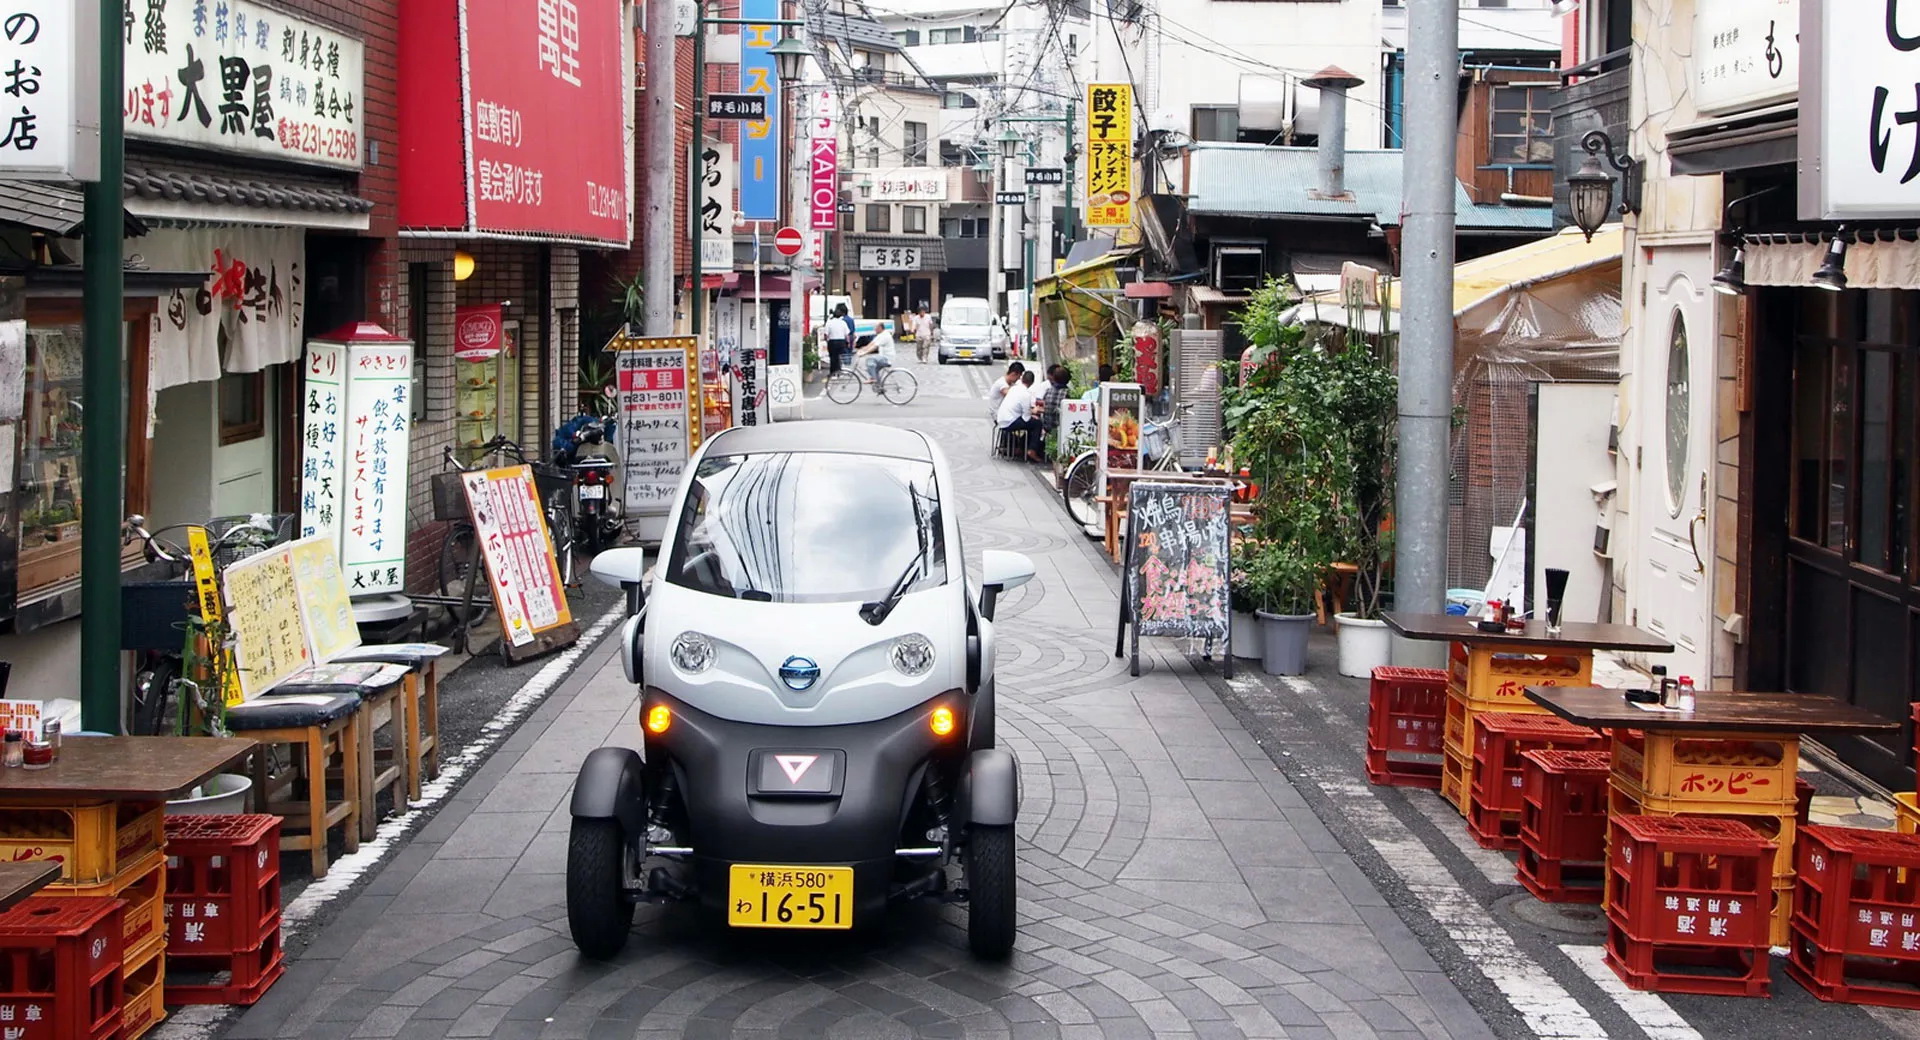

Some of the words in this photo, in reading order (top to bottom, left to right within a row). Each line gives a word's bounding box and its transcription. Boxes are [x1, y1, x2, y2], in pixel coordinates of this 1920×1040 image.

[281, 24, 340, 80] 刺身各種
[0, 12, 41, 151] のお店
[124, 75, 174, 128] ります
[177, 43, 275, 141] 大黒屋
[314, 76, 354, 124] 盛合せ
[477, 98, 522, 148] 座敷有り
[710, 101, 763, 114] 野毛小路
[1093, 88, 1117, 138] 餃子
[302, 122, 357, 160] 231-2598
[478, 157, 543, 206] 宴会承ります
[813, 140, 834, 226] KATOH
[1092, 143, 1103, 194] ラーメン
[1106, 143, 1117, 190] チンチン
[311, 352, 337, 377] とり
[359, 354, 408, 371] やきとり
[391, 384, 407, 432] 宴会
[632, 391, 683, 402] 231-8011
[352, 414, 369, 538] サービスします
[369, 399, 389, 552] 飲み放題有ります
[1139, 493, 1182, 530] 焼鳥
[352, 567, 400, 589] 大黒屋
[1680, 771, 1770, 795] ホッピー
[760, 871, 826, 888] 横浜580
[736, 899, 752, 914] わ
[762, 892, 841, 924] 16-51
